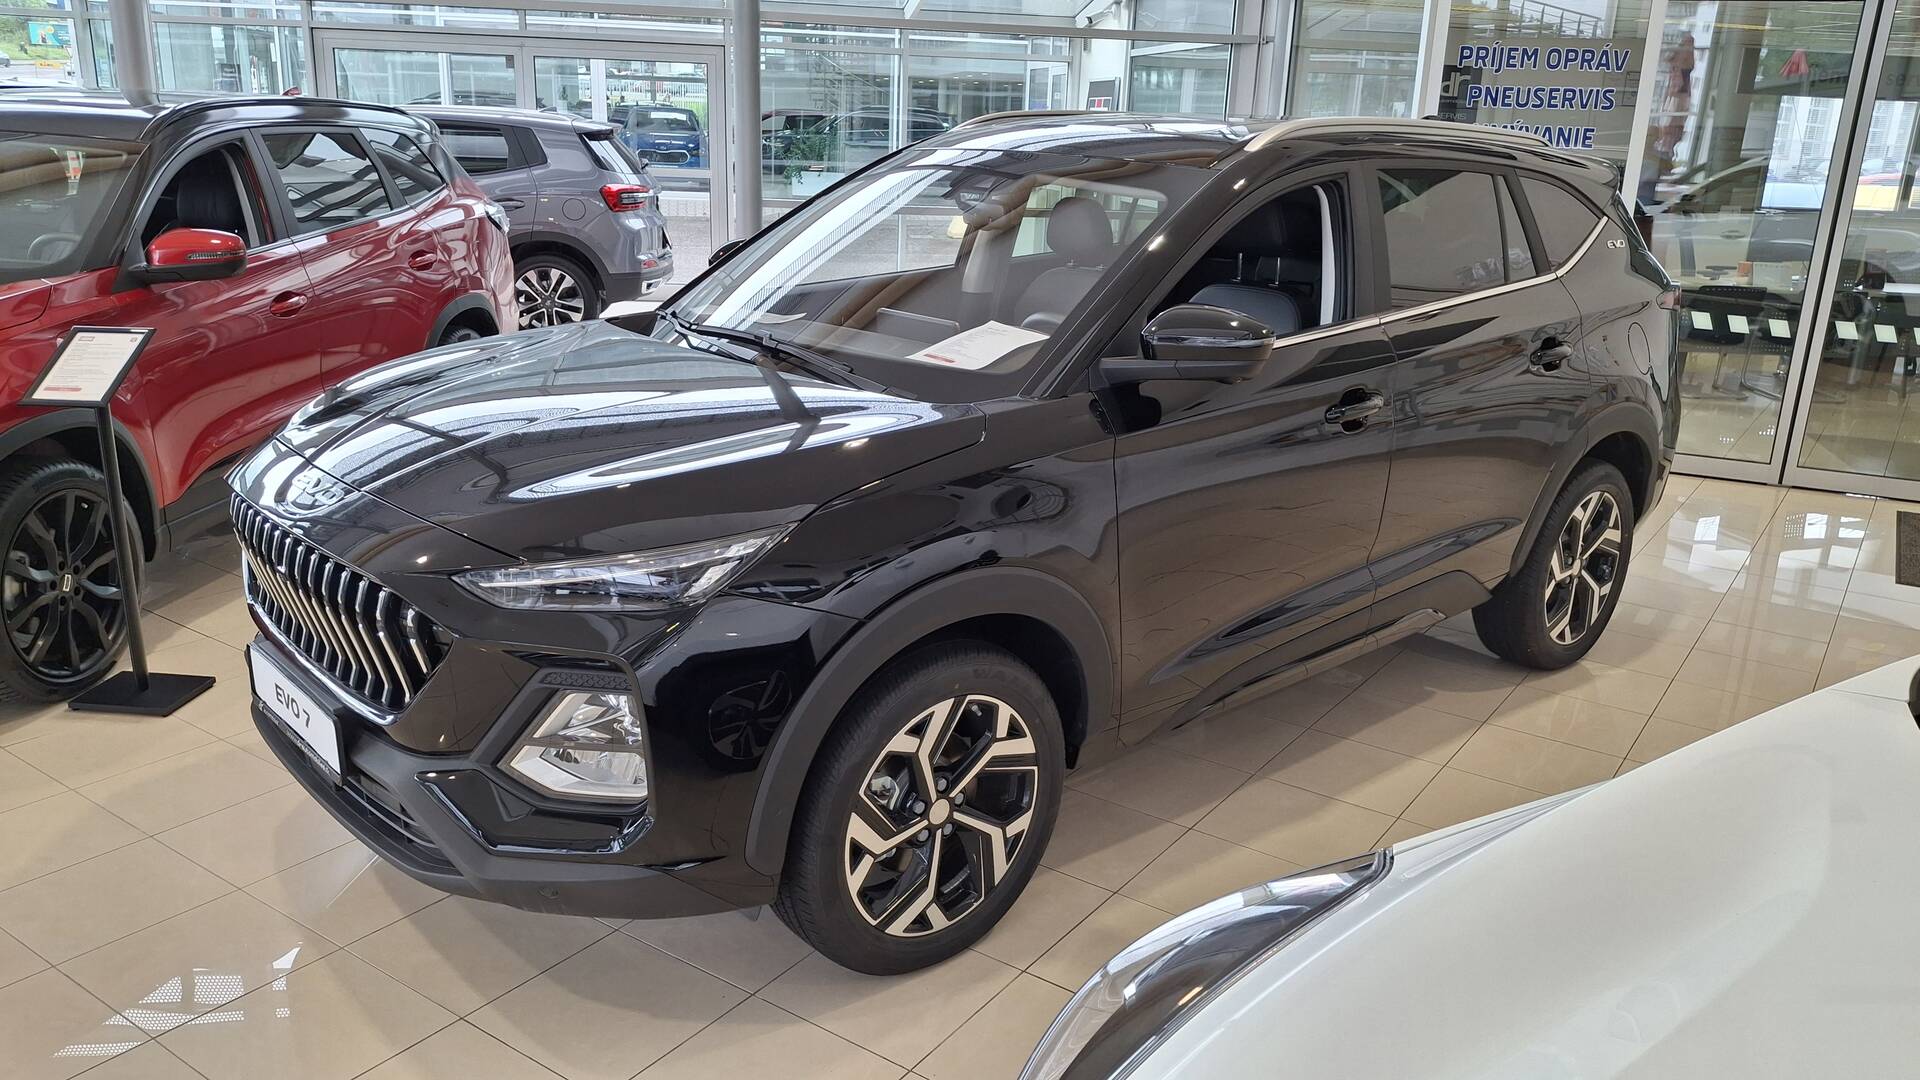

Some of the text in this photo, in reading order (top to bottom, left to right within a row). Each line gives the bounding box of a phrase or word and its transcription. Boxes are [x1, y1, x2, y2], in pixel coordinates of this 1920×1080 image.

[1457, 41, 1630, 74] PRÍJEM OPRÁV
[1466, 84, 1616, 111] PNEUSERVIS
[1439, 112, 1466, 120] ERVIS
[1475, 119, 1595, 149] ANIE
[1607, 240, 1625, 249] EVO
[274, 682, 300, 719] EVO
[302, 708, 311, 729] 7
